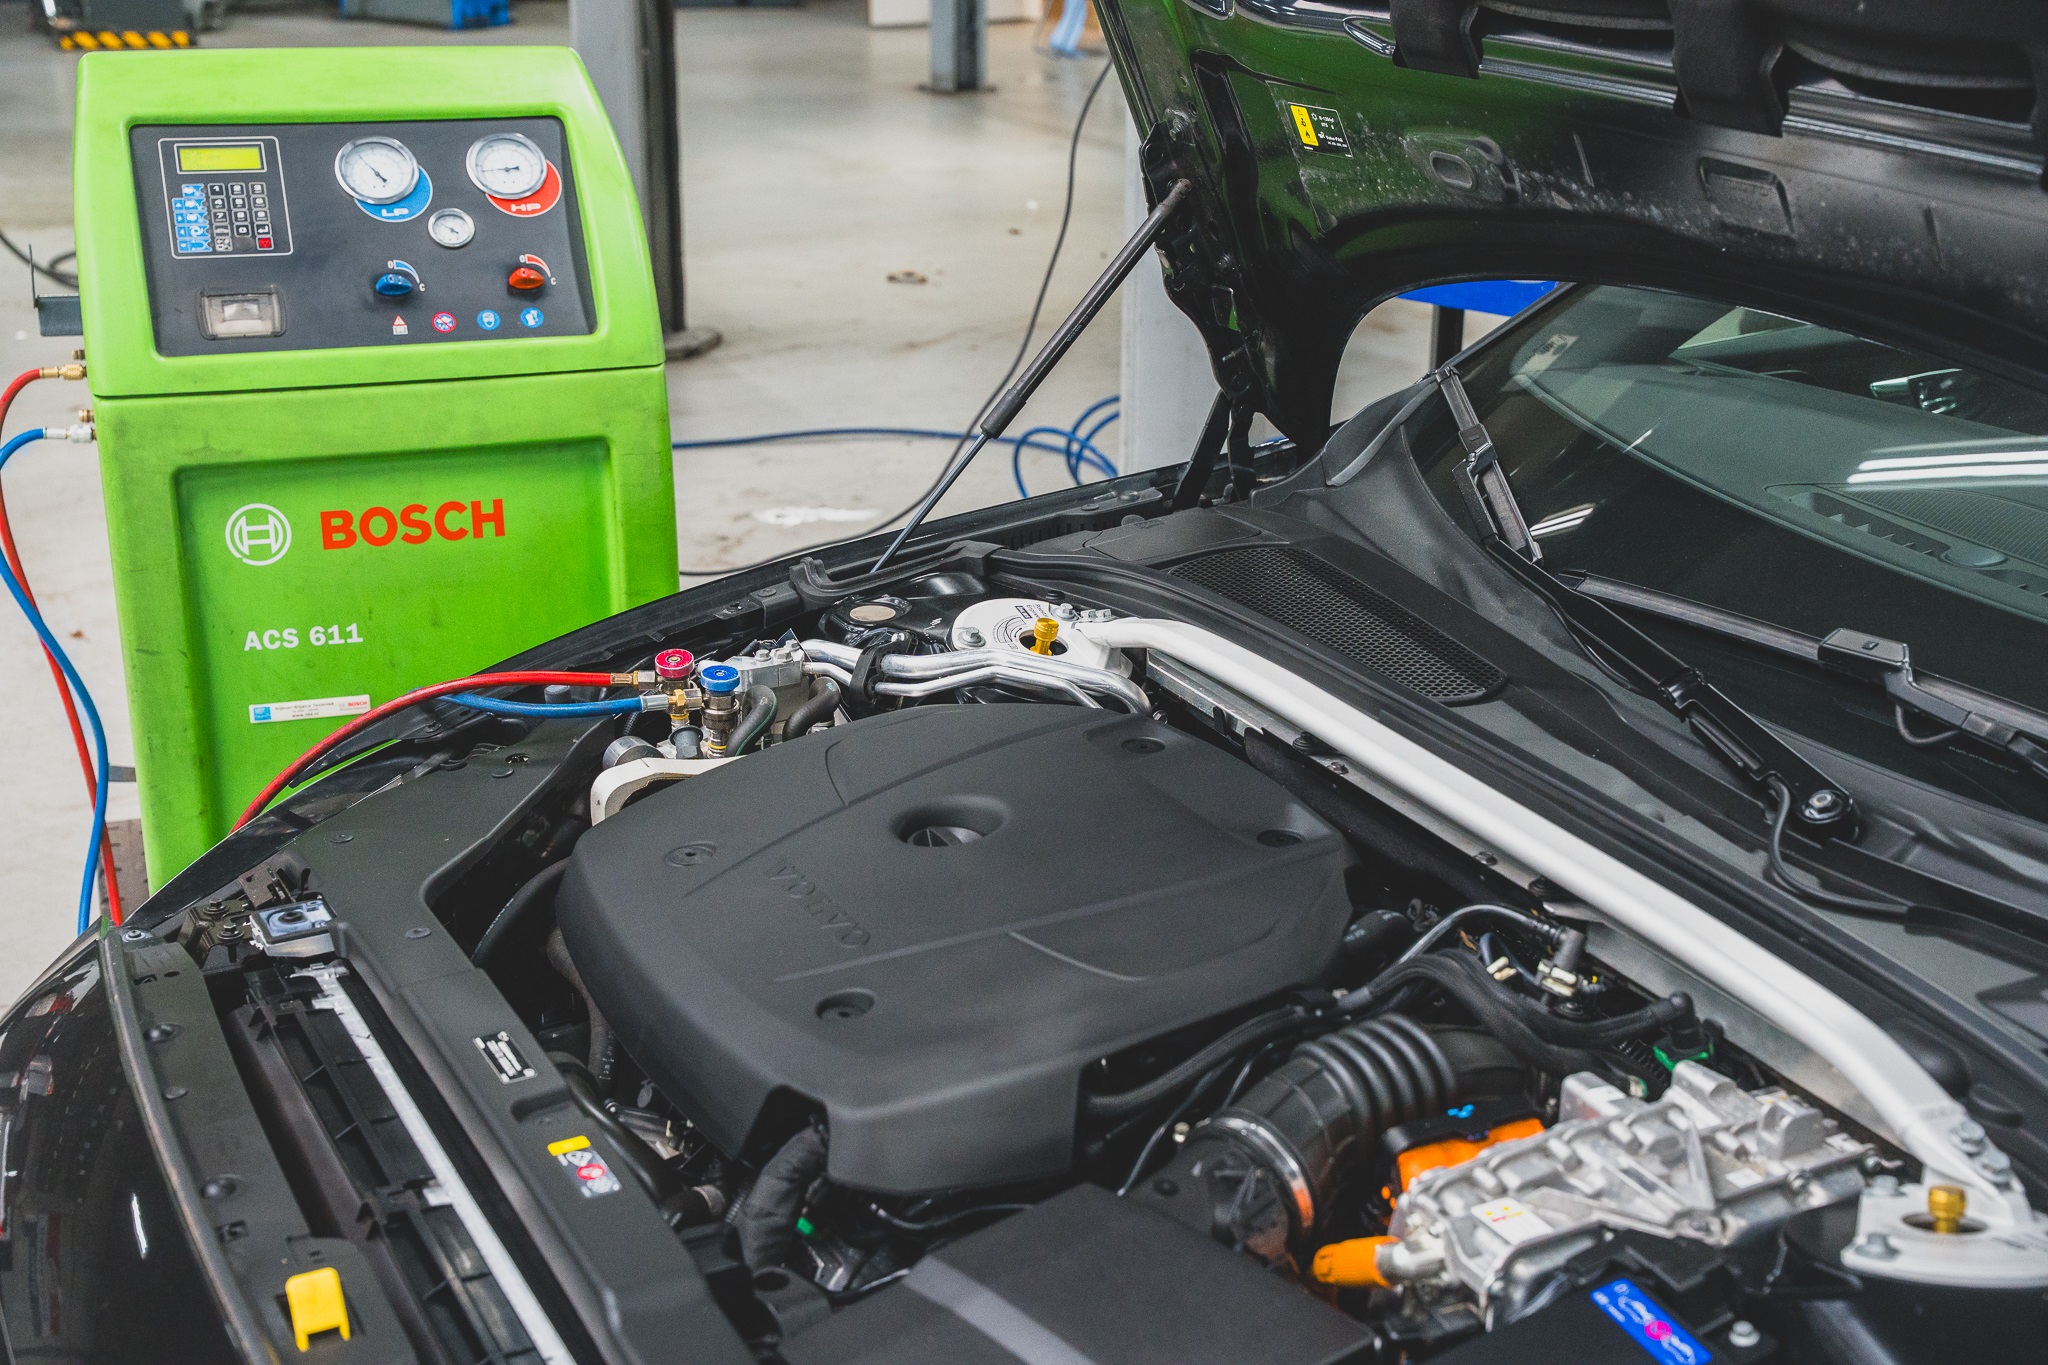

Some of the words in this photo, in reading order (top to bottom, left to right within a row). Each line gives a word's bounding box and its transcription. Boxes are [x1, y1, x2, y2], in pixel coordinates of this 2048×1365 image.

[510, 202, 542, 212] HP
[381, 207, 409, 218] LP
[550, 276, 557, 286] C
[418, 282, 426, 292] C
[320, 498, 506, 550] BOSCH
[243, 627, 300, 652] ACS
[309, 622, 364, 647] 611
